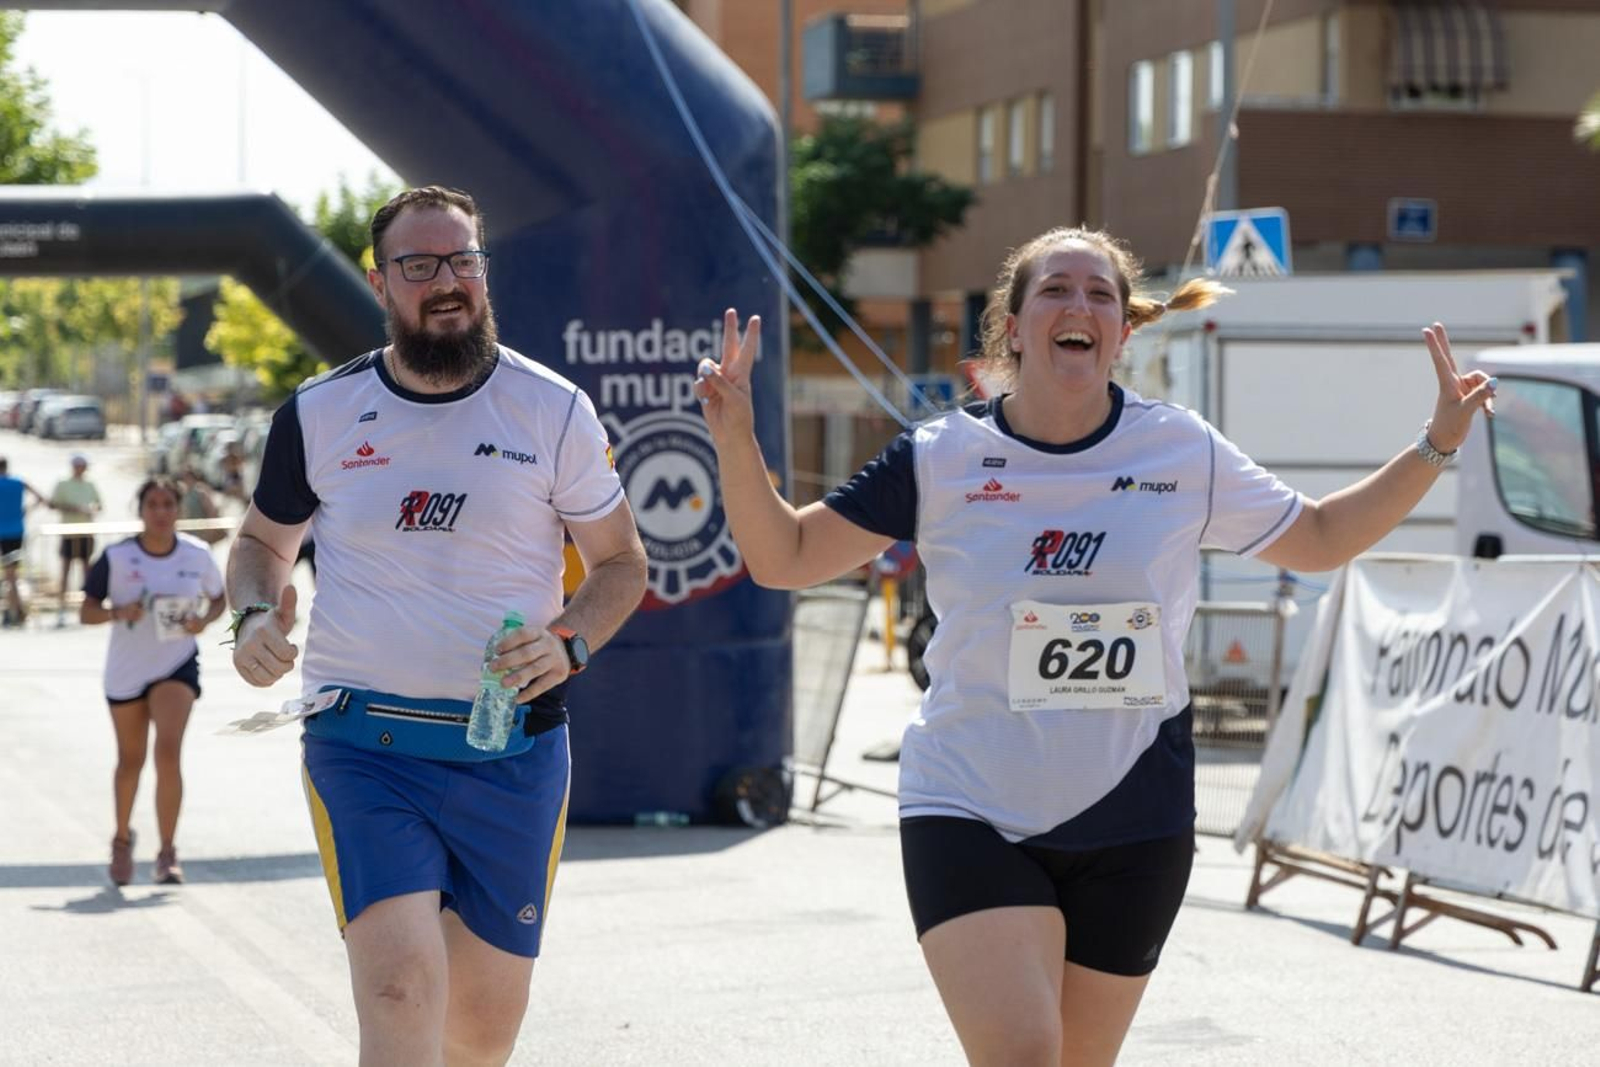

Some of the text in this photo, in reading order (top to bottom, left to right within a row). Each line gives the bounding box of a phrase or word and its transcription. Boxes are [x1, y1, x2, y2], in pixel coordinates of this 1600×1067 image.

[563, 319, 762, 363] fundaci
[341, 457, 391, 470] Santander
[502, 450, 537, 465] mupol
[1140, 481, 1178, 494] mupol
[965, 492, 1021, 503] Santander
[1038, 636, 1136, 680] 620
[1050, 686, 1072, 694] LAURA
[1073, 686, 1097, 694] GRILLO
